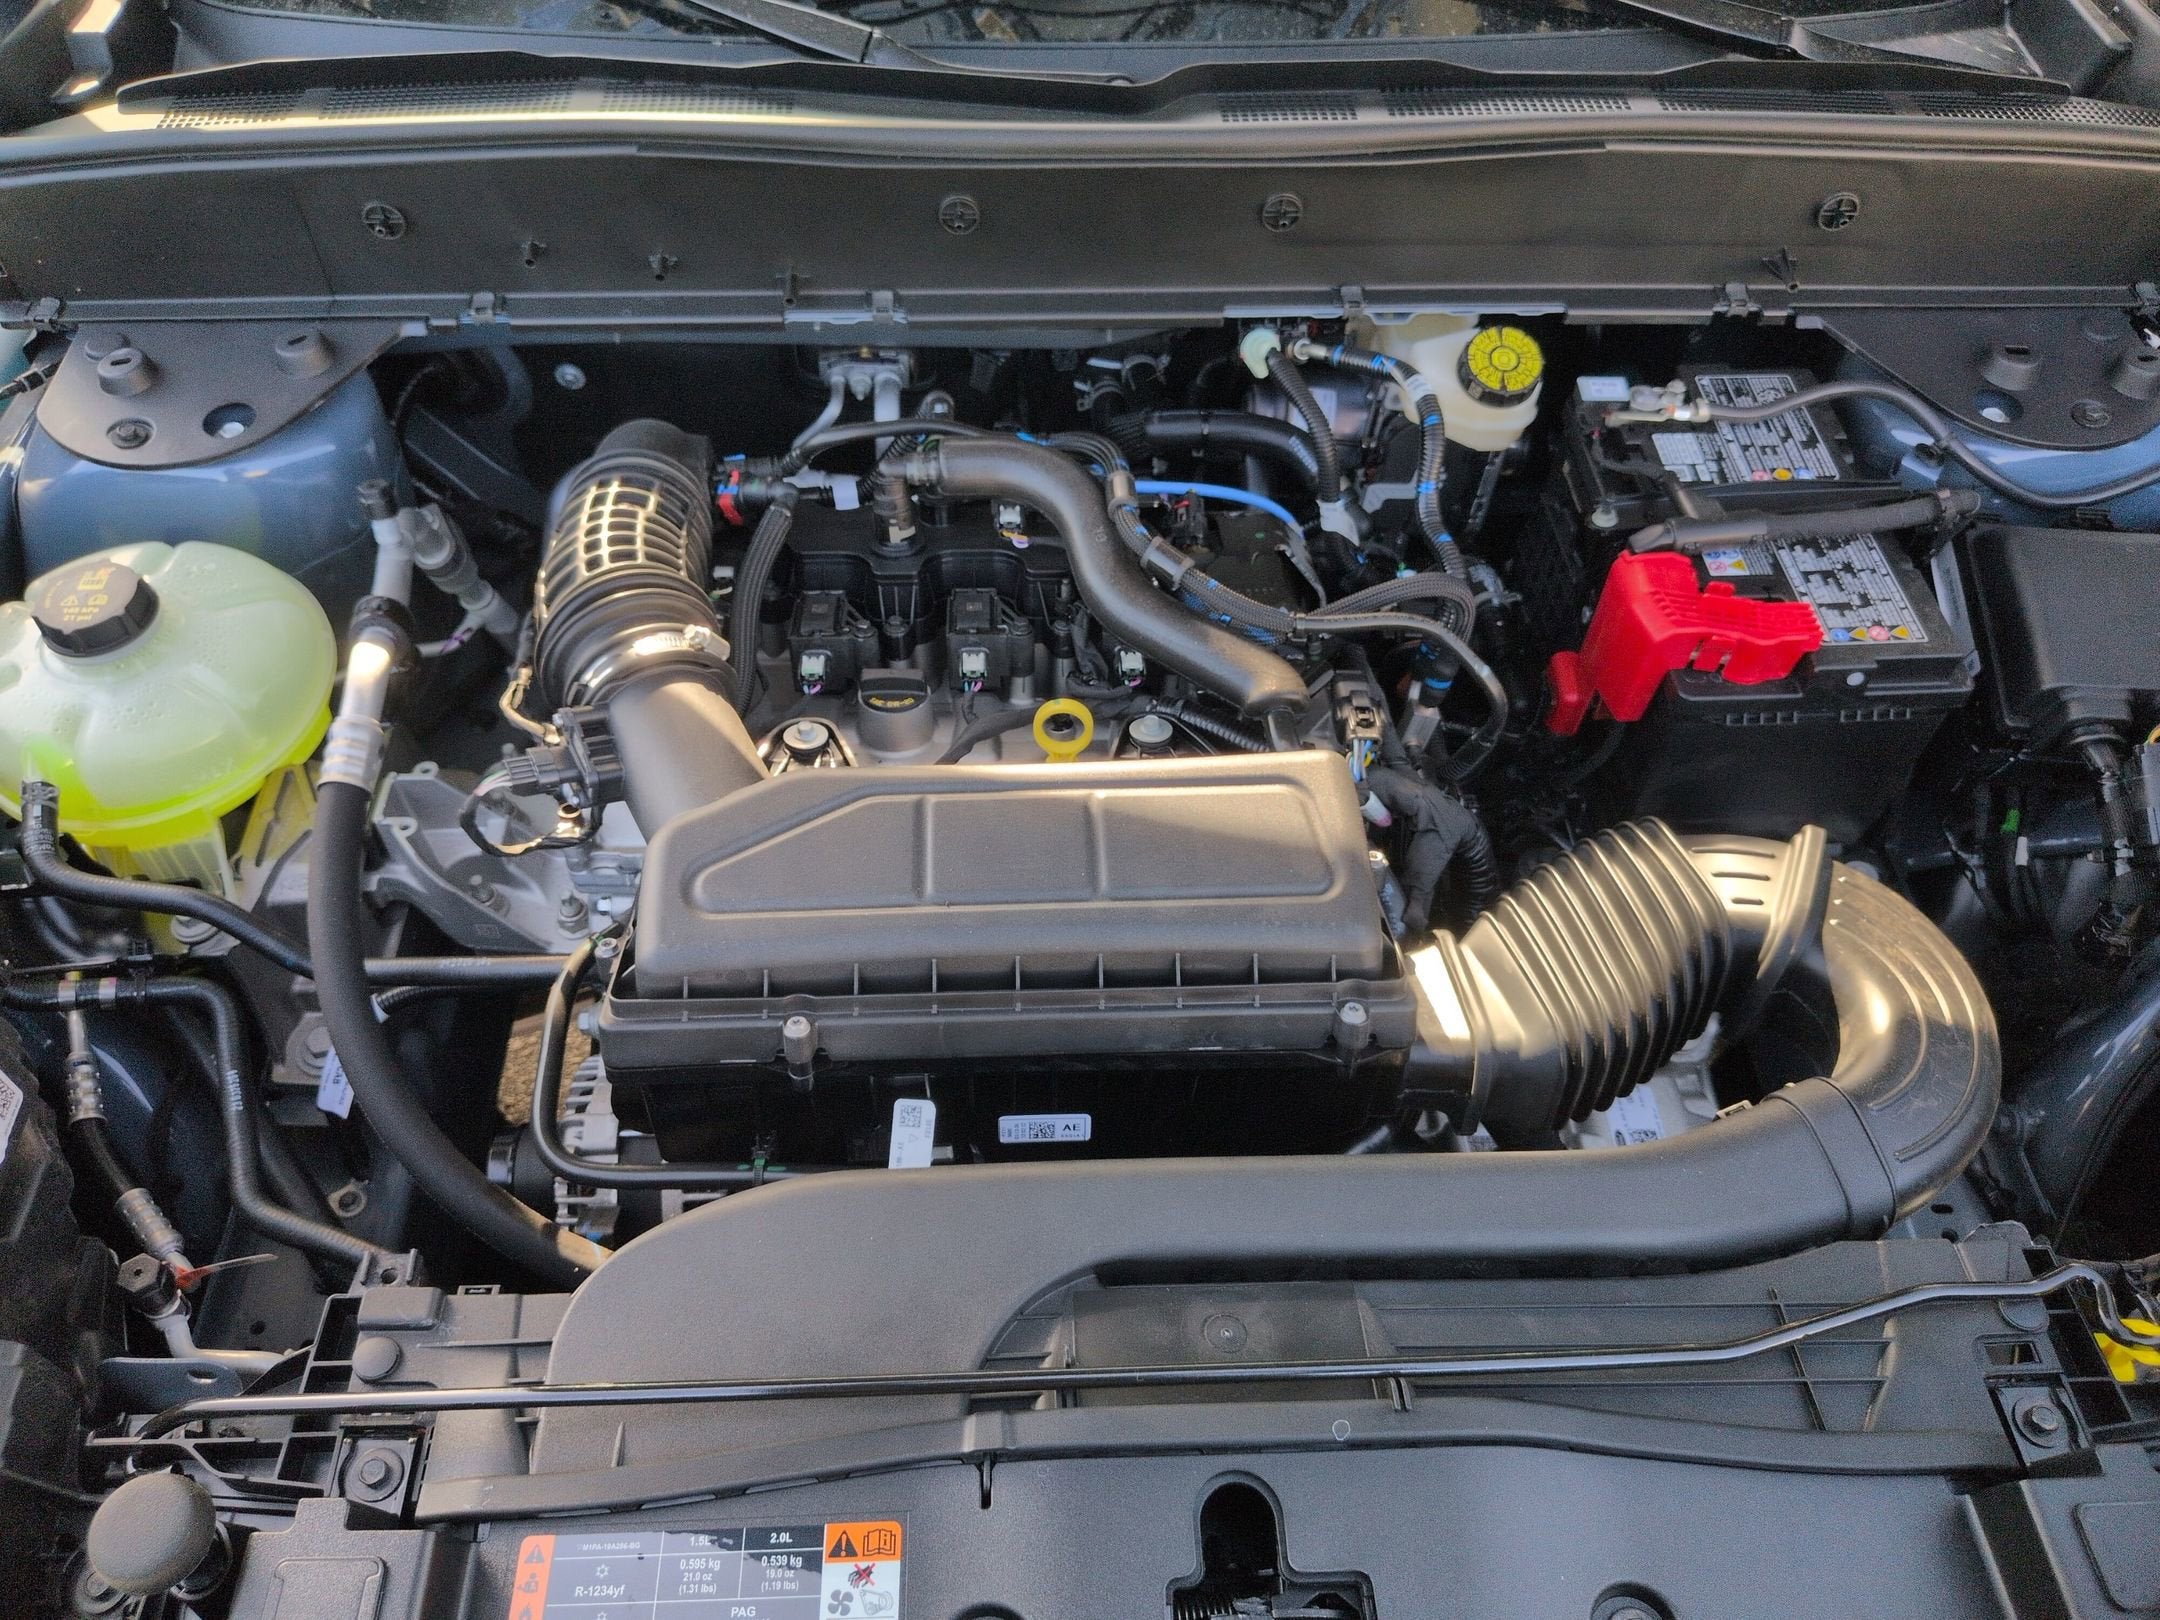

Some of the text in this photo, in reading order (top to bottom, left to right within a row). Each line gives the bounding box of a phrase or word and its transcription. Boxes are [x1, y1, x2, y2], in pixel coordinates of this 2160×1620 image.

[1062, 1123, 1080, 1131] AE
[690, 1535, 711, 1546] 1.5L
[770, 1532, 793, 1543] 2.0L
[680, 1557, 720, 1571] 0.595 kg
[761, 1554, 802, 1568] 0.539 kg
[683, 1572, 700, 1581] 21.0
[766, 1569, 794, 1578] 19.0 oz
[575, 1584, 625, 1599] R-1234yf
[679, 1583, 716, 1595] (1.31 lbs)
[761, 1580, 799, 1592] (1.19 lbs)
[731, 1606, 756, 1618] PAG
